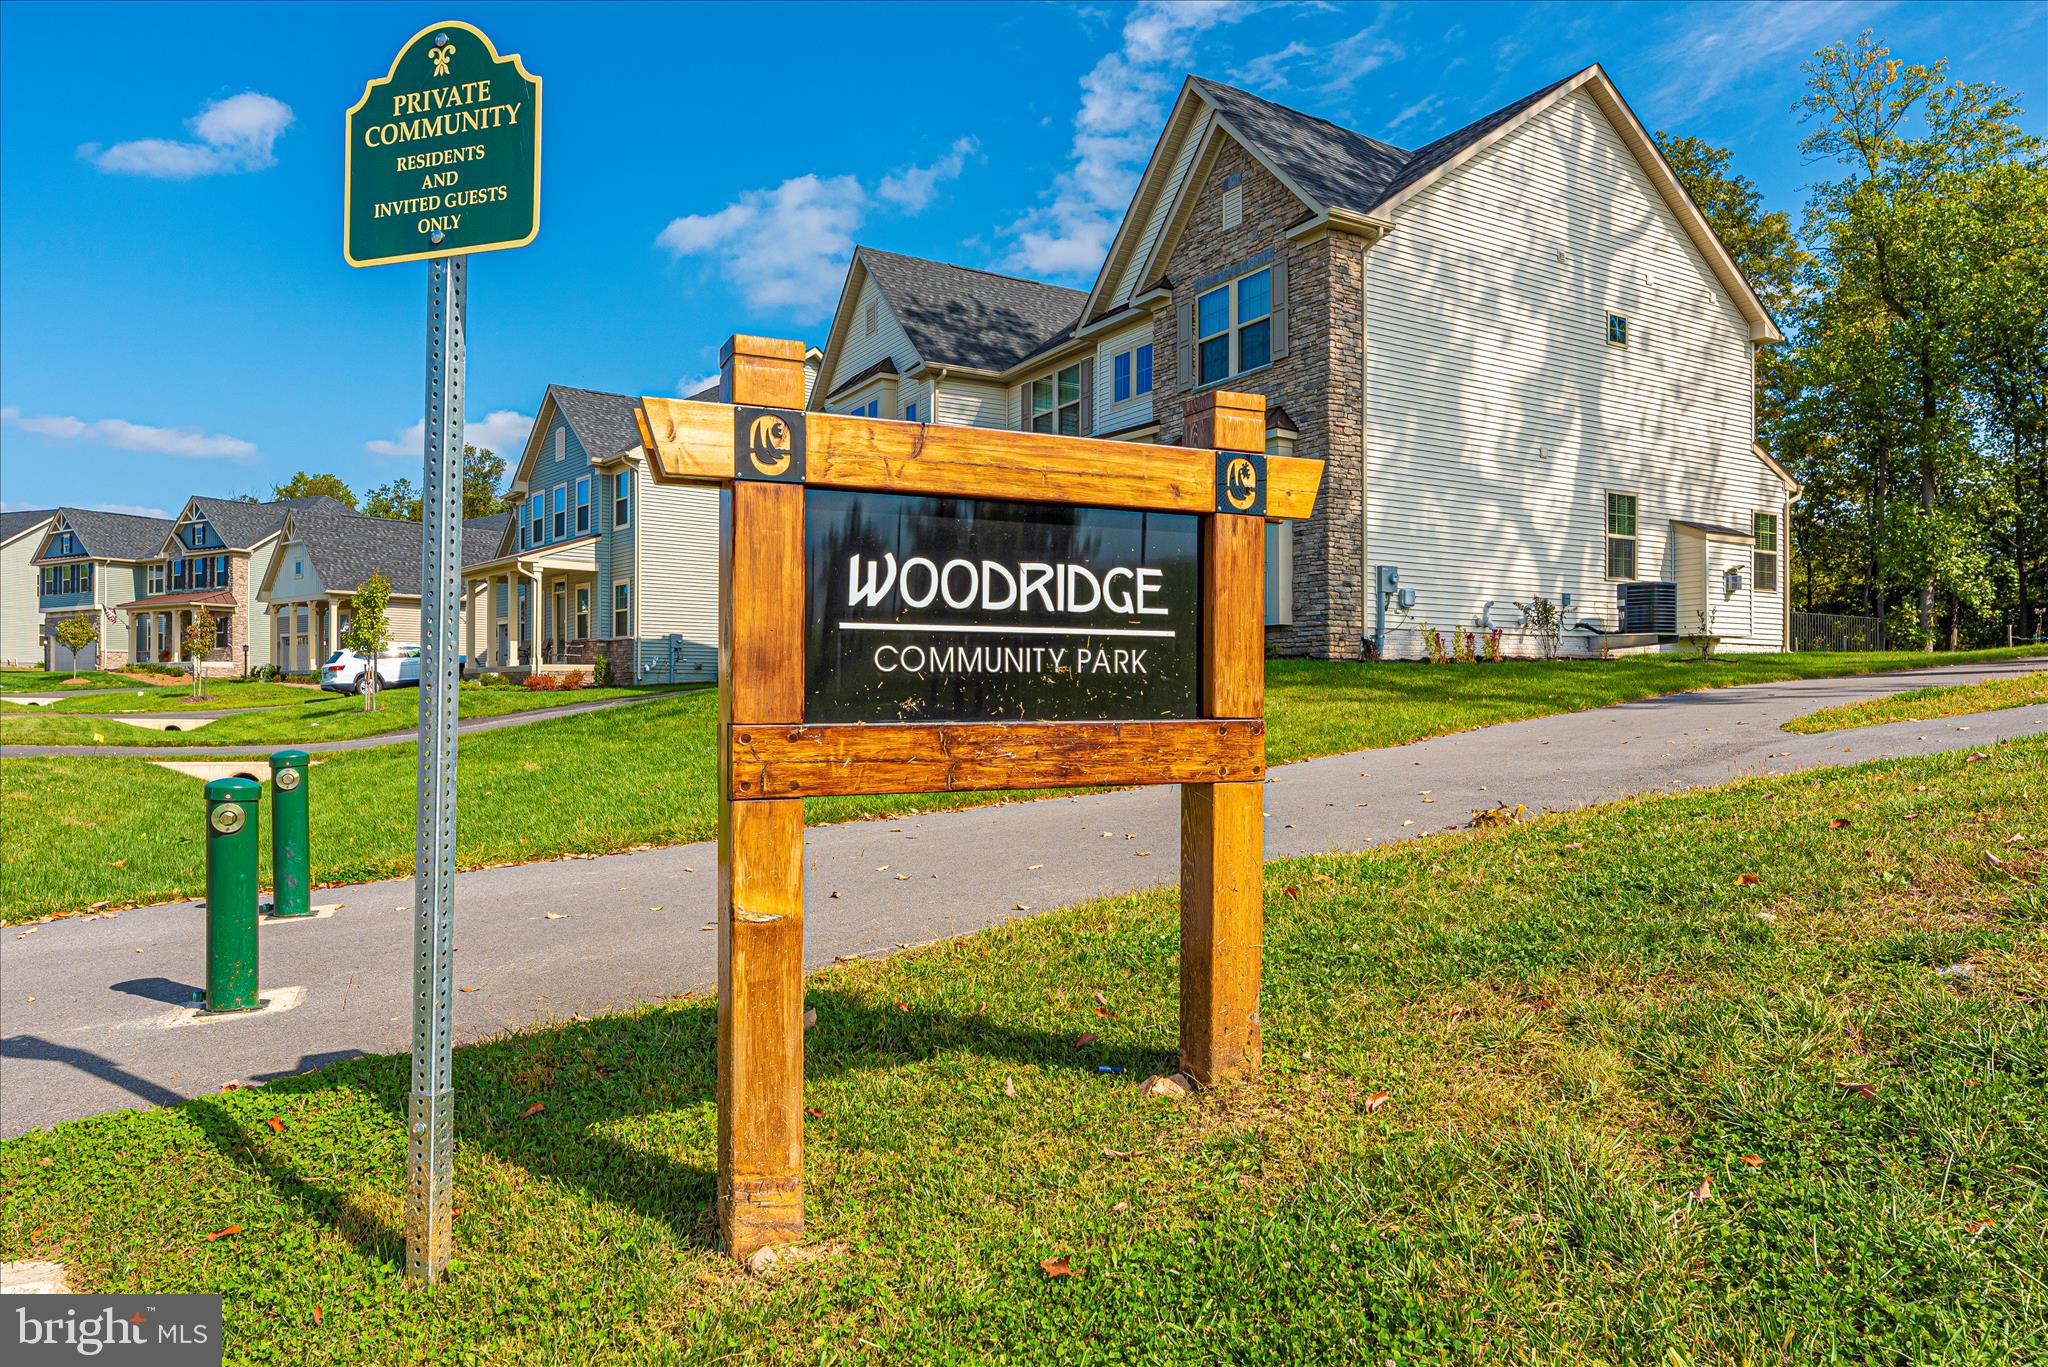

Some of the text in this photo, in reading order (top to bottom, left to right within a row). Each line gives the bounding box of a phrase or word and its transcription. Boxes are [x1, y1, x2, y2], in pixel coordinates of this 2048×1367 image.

[393, 80, 491, 116] PRIVATE
[365, 103, 521, 147] COMMUNITY
[397, 145, 485, 171] RESIDENTS
[421, 171, 459, 190] AND
[374, 186, 508, 218] INVITED GUESTS
[417, 214, 462, 234] ONLY
[847, 552, 1168, 615] WOODRIDGE
[873, 645, 1147, 674] COMMUNITY PARK
